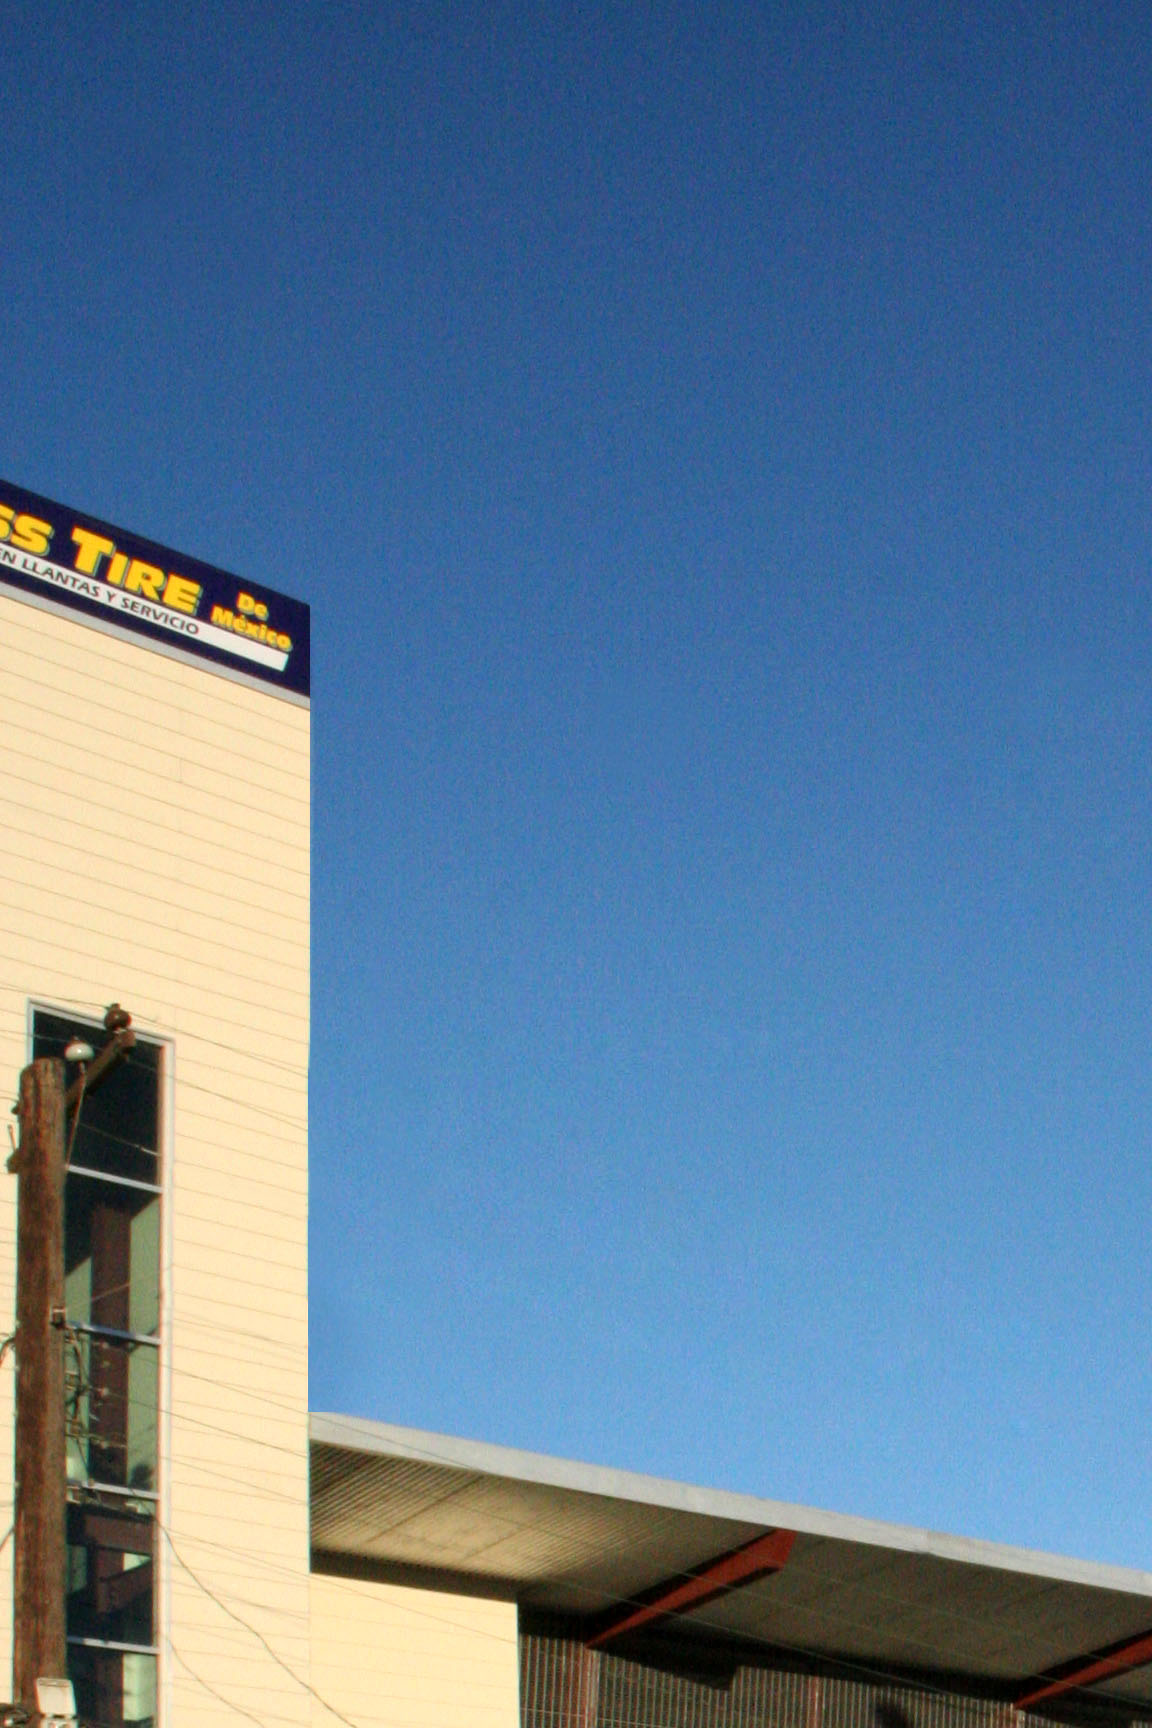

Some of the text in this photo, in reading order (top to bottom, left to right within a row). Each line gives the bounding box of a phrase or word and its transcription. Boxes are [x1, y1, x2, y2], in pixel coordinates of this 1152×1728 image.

[22, 558, 100, 597] LLANTAS
[106, 590, 116, 604] Y
[121, 596, 199, 636] SERVICIO
[71, 525, 202, 615] TIRE
[211, 605, 292, 652] México
[236, 591, 269, 620] De
